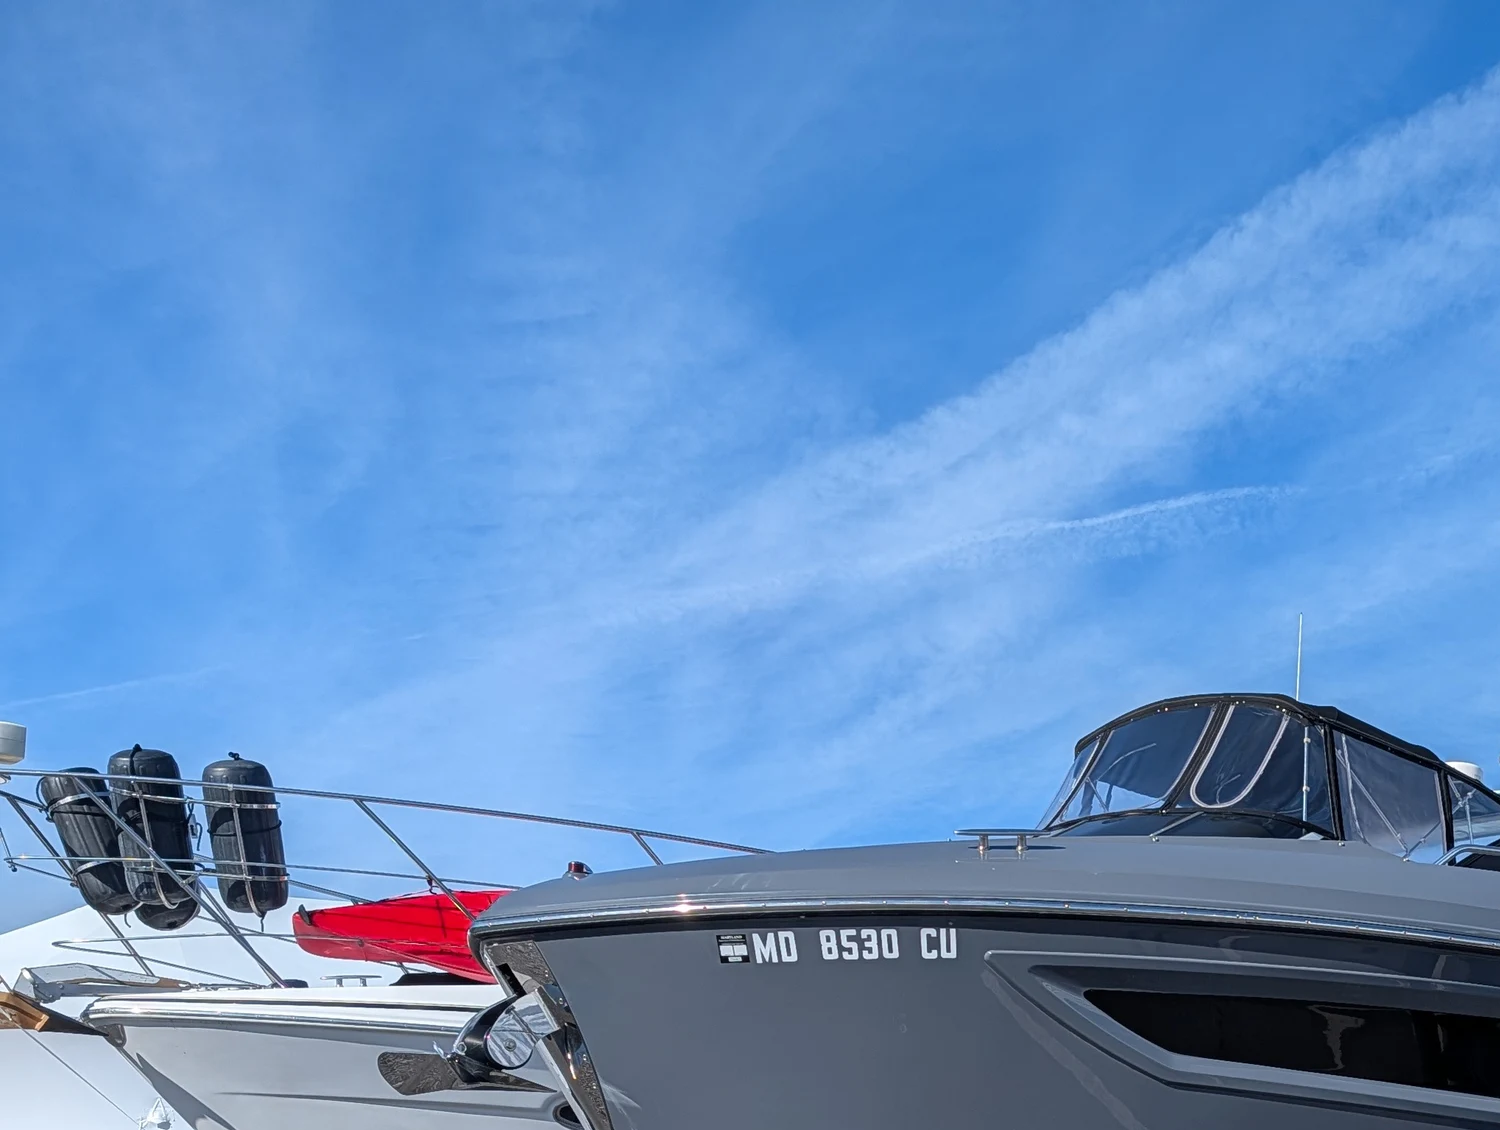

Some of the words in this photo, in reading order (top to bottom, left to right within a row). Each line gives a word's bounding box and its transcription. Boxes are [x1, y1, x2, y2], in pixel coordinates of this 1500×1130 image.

[752, 931, 798, 964] MD
[819, 928, 900, 960] 8530
[920, 927, 957, 960] CU
